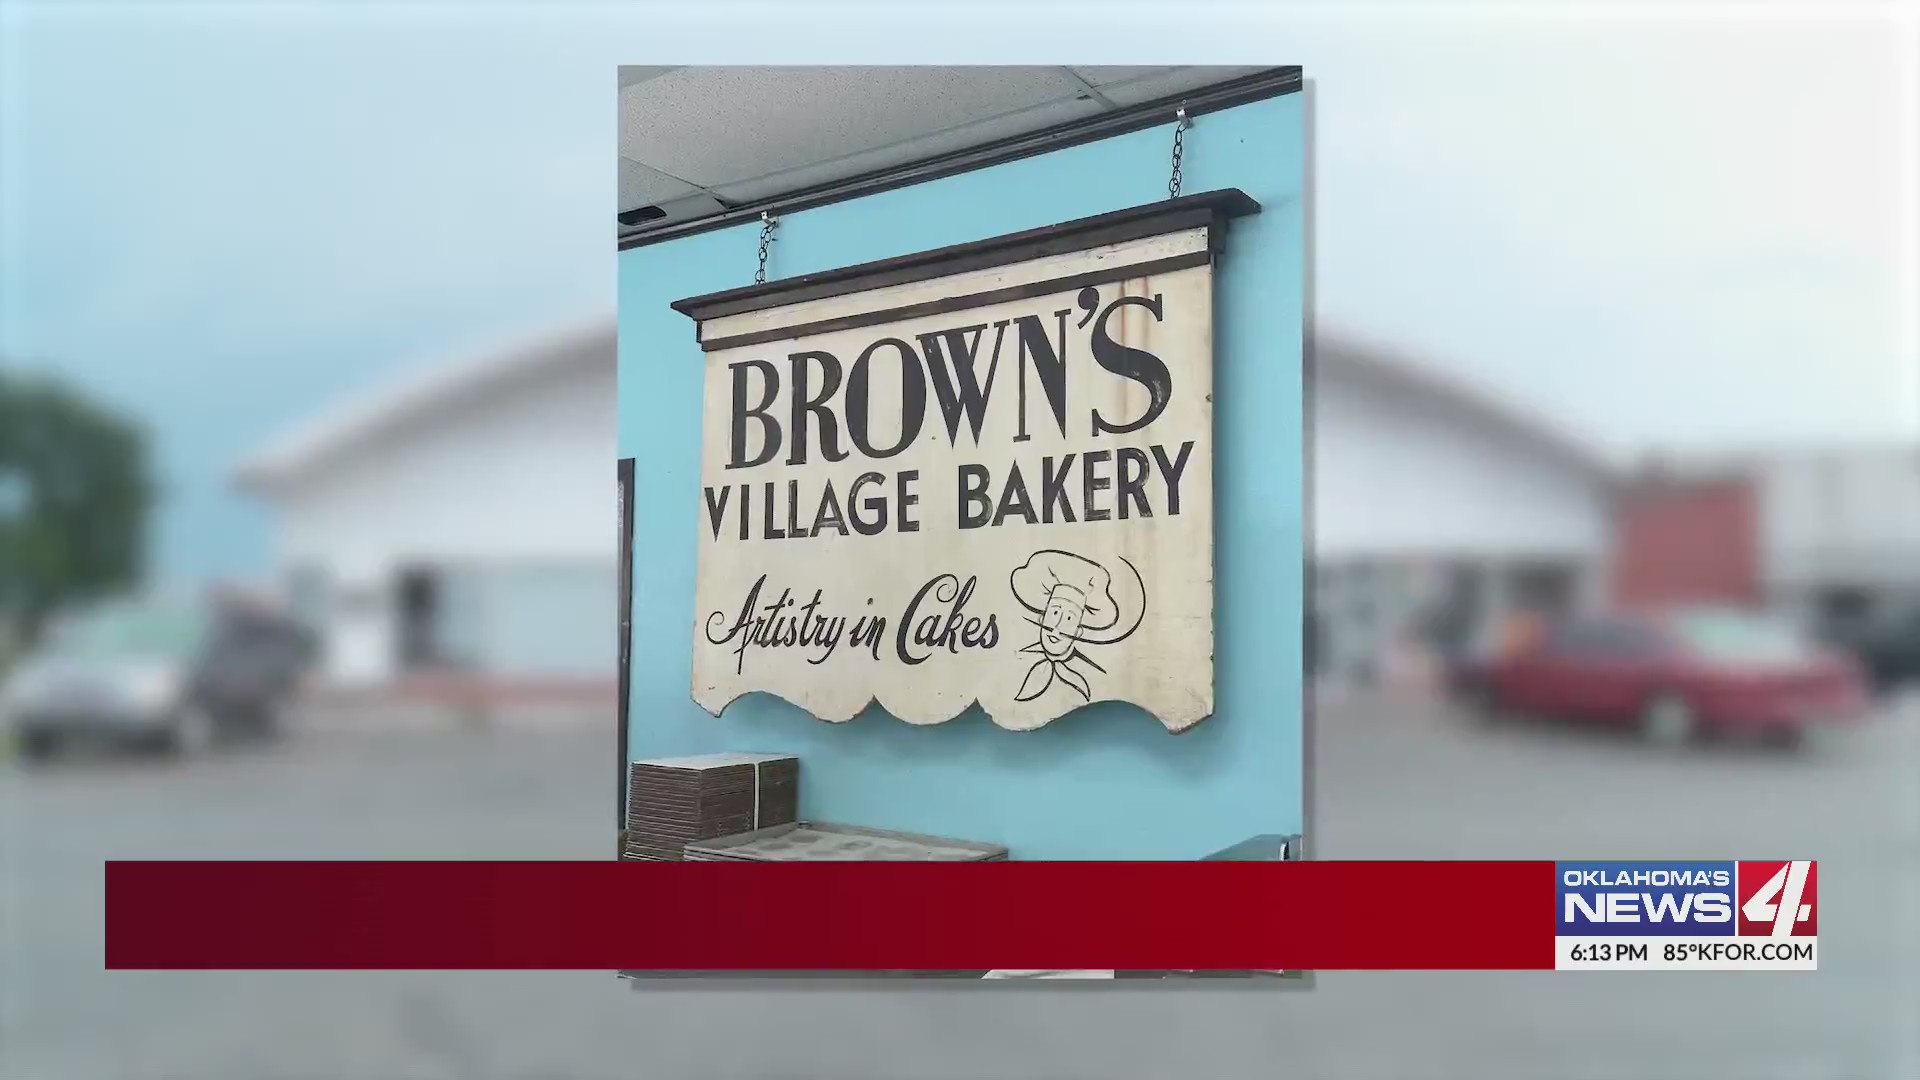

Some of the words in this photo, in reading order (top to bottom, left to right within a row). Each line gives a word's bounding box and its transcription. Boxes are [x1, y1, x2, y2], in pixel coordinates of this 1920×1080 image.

[725, 286, 1173, 470] BROWN'S
[703, 469, 921, 543] VILLAGE
[957, 440, 1195, 531] BAKERY
[705, 573, 848, 676] Artistry
[849, 597, 886, 662] in
[896, 573, 1000, 666] Cakes
